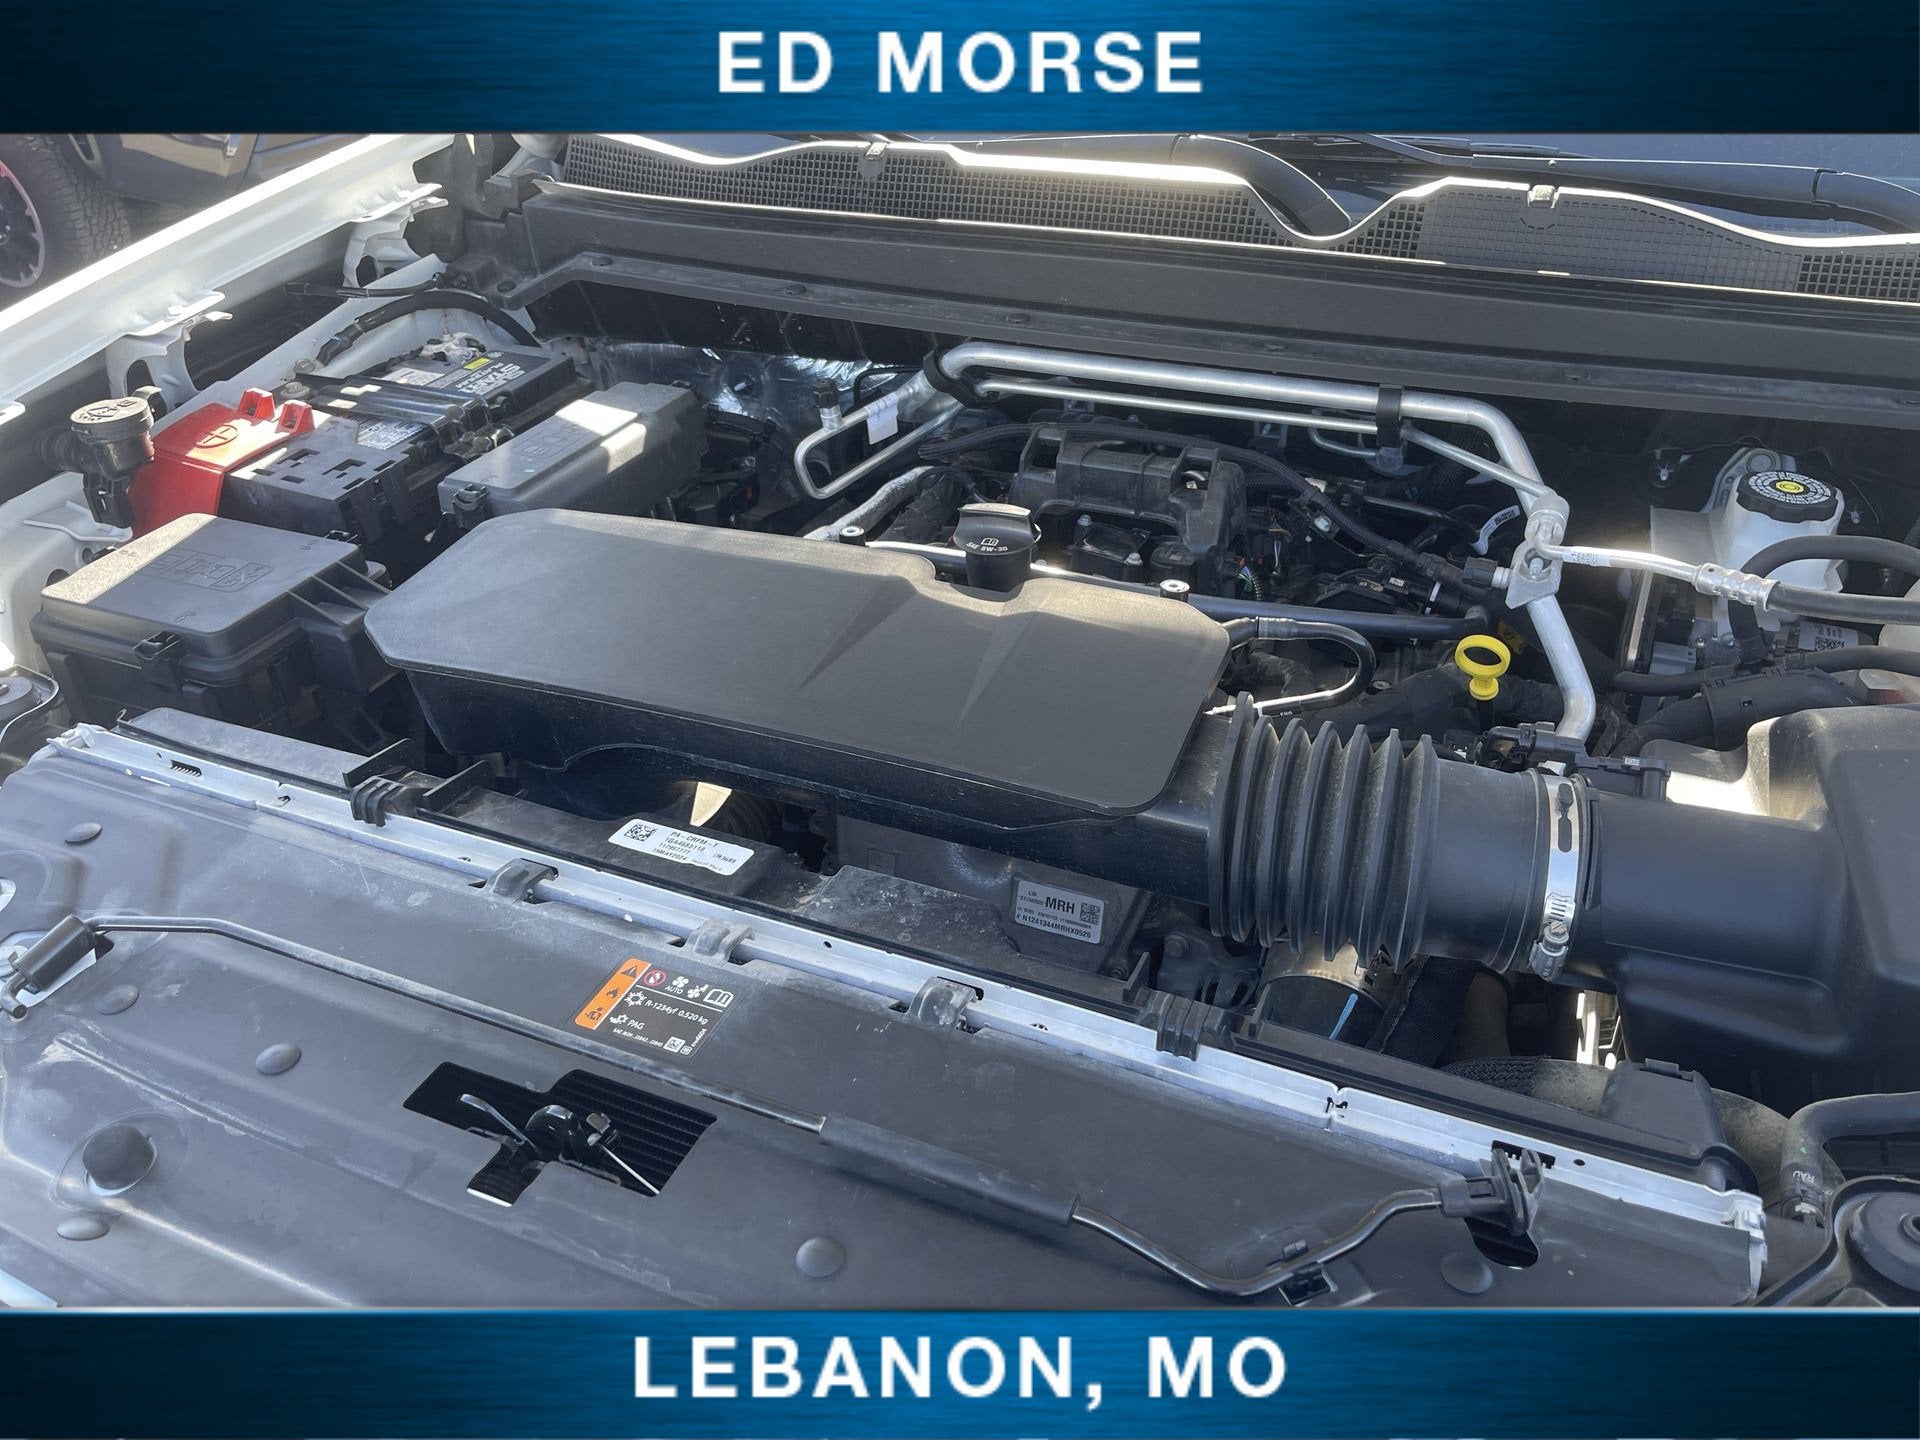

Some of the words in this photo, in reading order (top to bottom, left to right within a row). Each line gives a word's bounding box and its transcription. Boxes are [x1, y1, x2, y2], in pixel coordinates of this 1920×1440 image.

[966, 541, 980, 550] SAE
[1045, 896, 1075, 914] MRH
[664, 985, 684, 995] AUTO
[644, 1000, 678, 1014] R-1234yf
[678, 1009, 698, 1021] 0.520
[698, 1015, 709, 1026] kg
[627, 1019, 646, 1030] PAG
